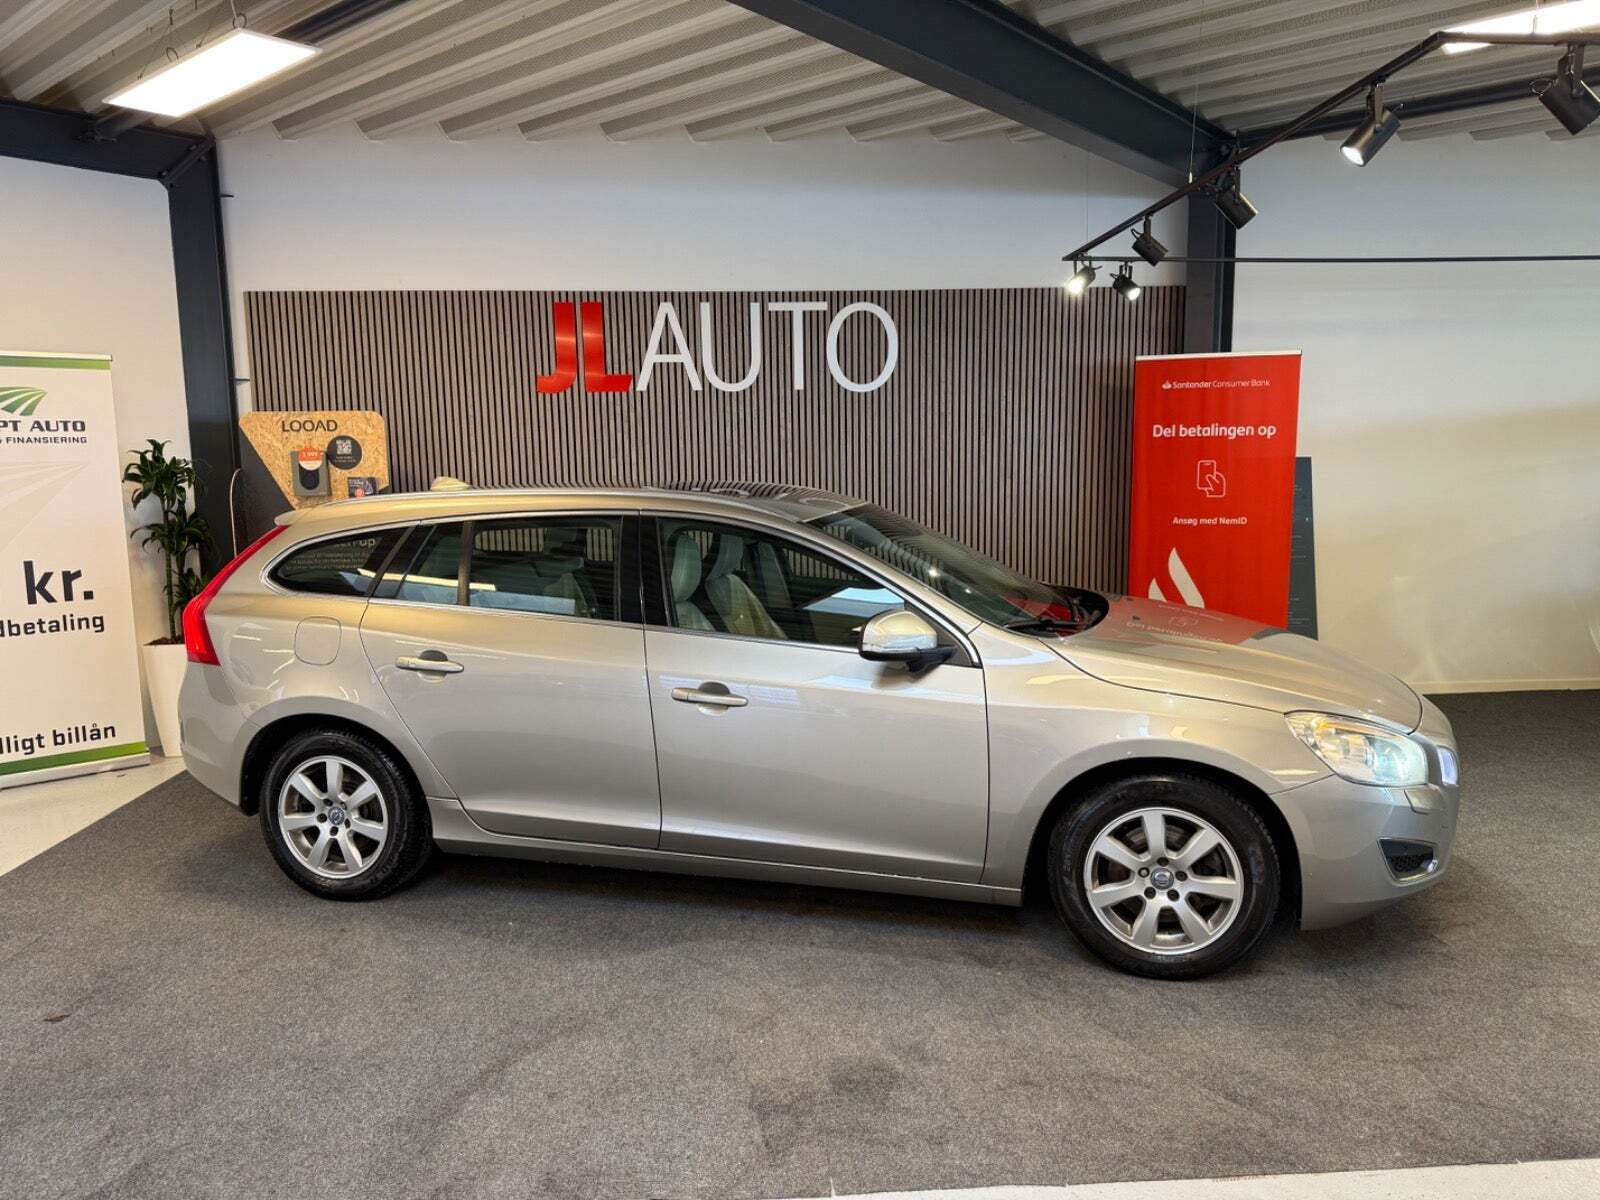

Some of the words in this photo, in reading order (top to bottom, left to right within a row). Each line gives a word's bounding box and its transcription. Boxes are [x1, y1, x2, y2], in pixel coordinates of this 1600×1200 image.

[536, 301, 632, 393] JL
[636, 301, 899, 392] AUTO
[1172, 381, 1211, 389] Santander
[1213, 379, 1250, 387] Consumer
[1251, 379, 1270, 387] Bank
[30, 420, 86, 432] AUTO
[281, 419, 338, 433] LOOAD
[1153, 424, 1176, 437] Del
[1179, 423, 1254, 439] betalingen
[1258, 425, 1277, 438] op
[5, 436, 87, 444] FINANSIERING
[1173, 516, 1198, 526] Ansøg
[1200, 517, 1218, 525] med
[1220, 516, 1248, 525] NemID
[24, 560, 94, 605] kr.
[52, 723, 116, 746] billån
